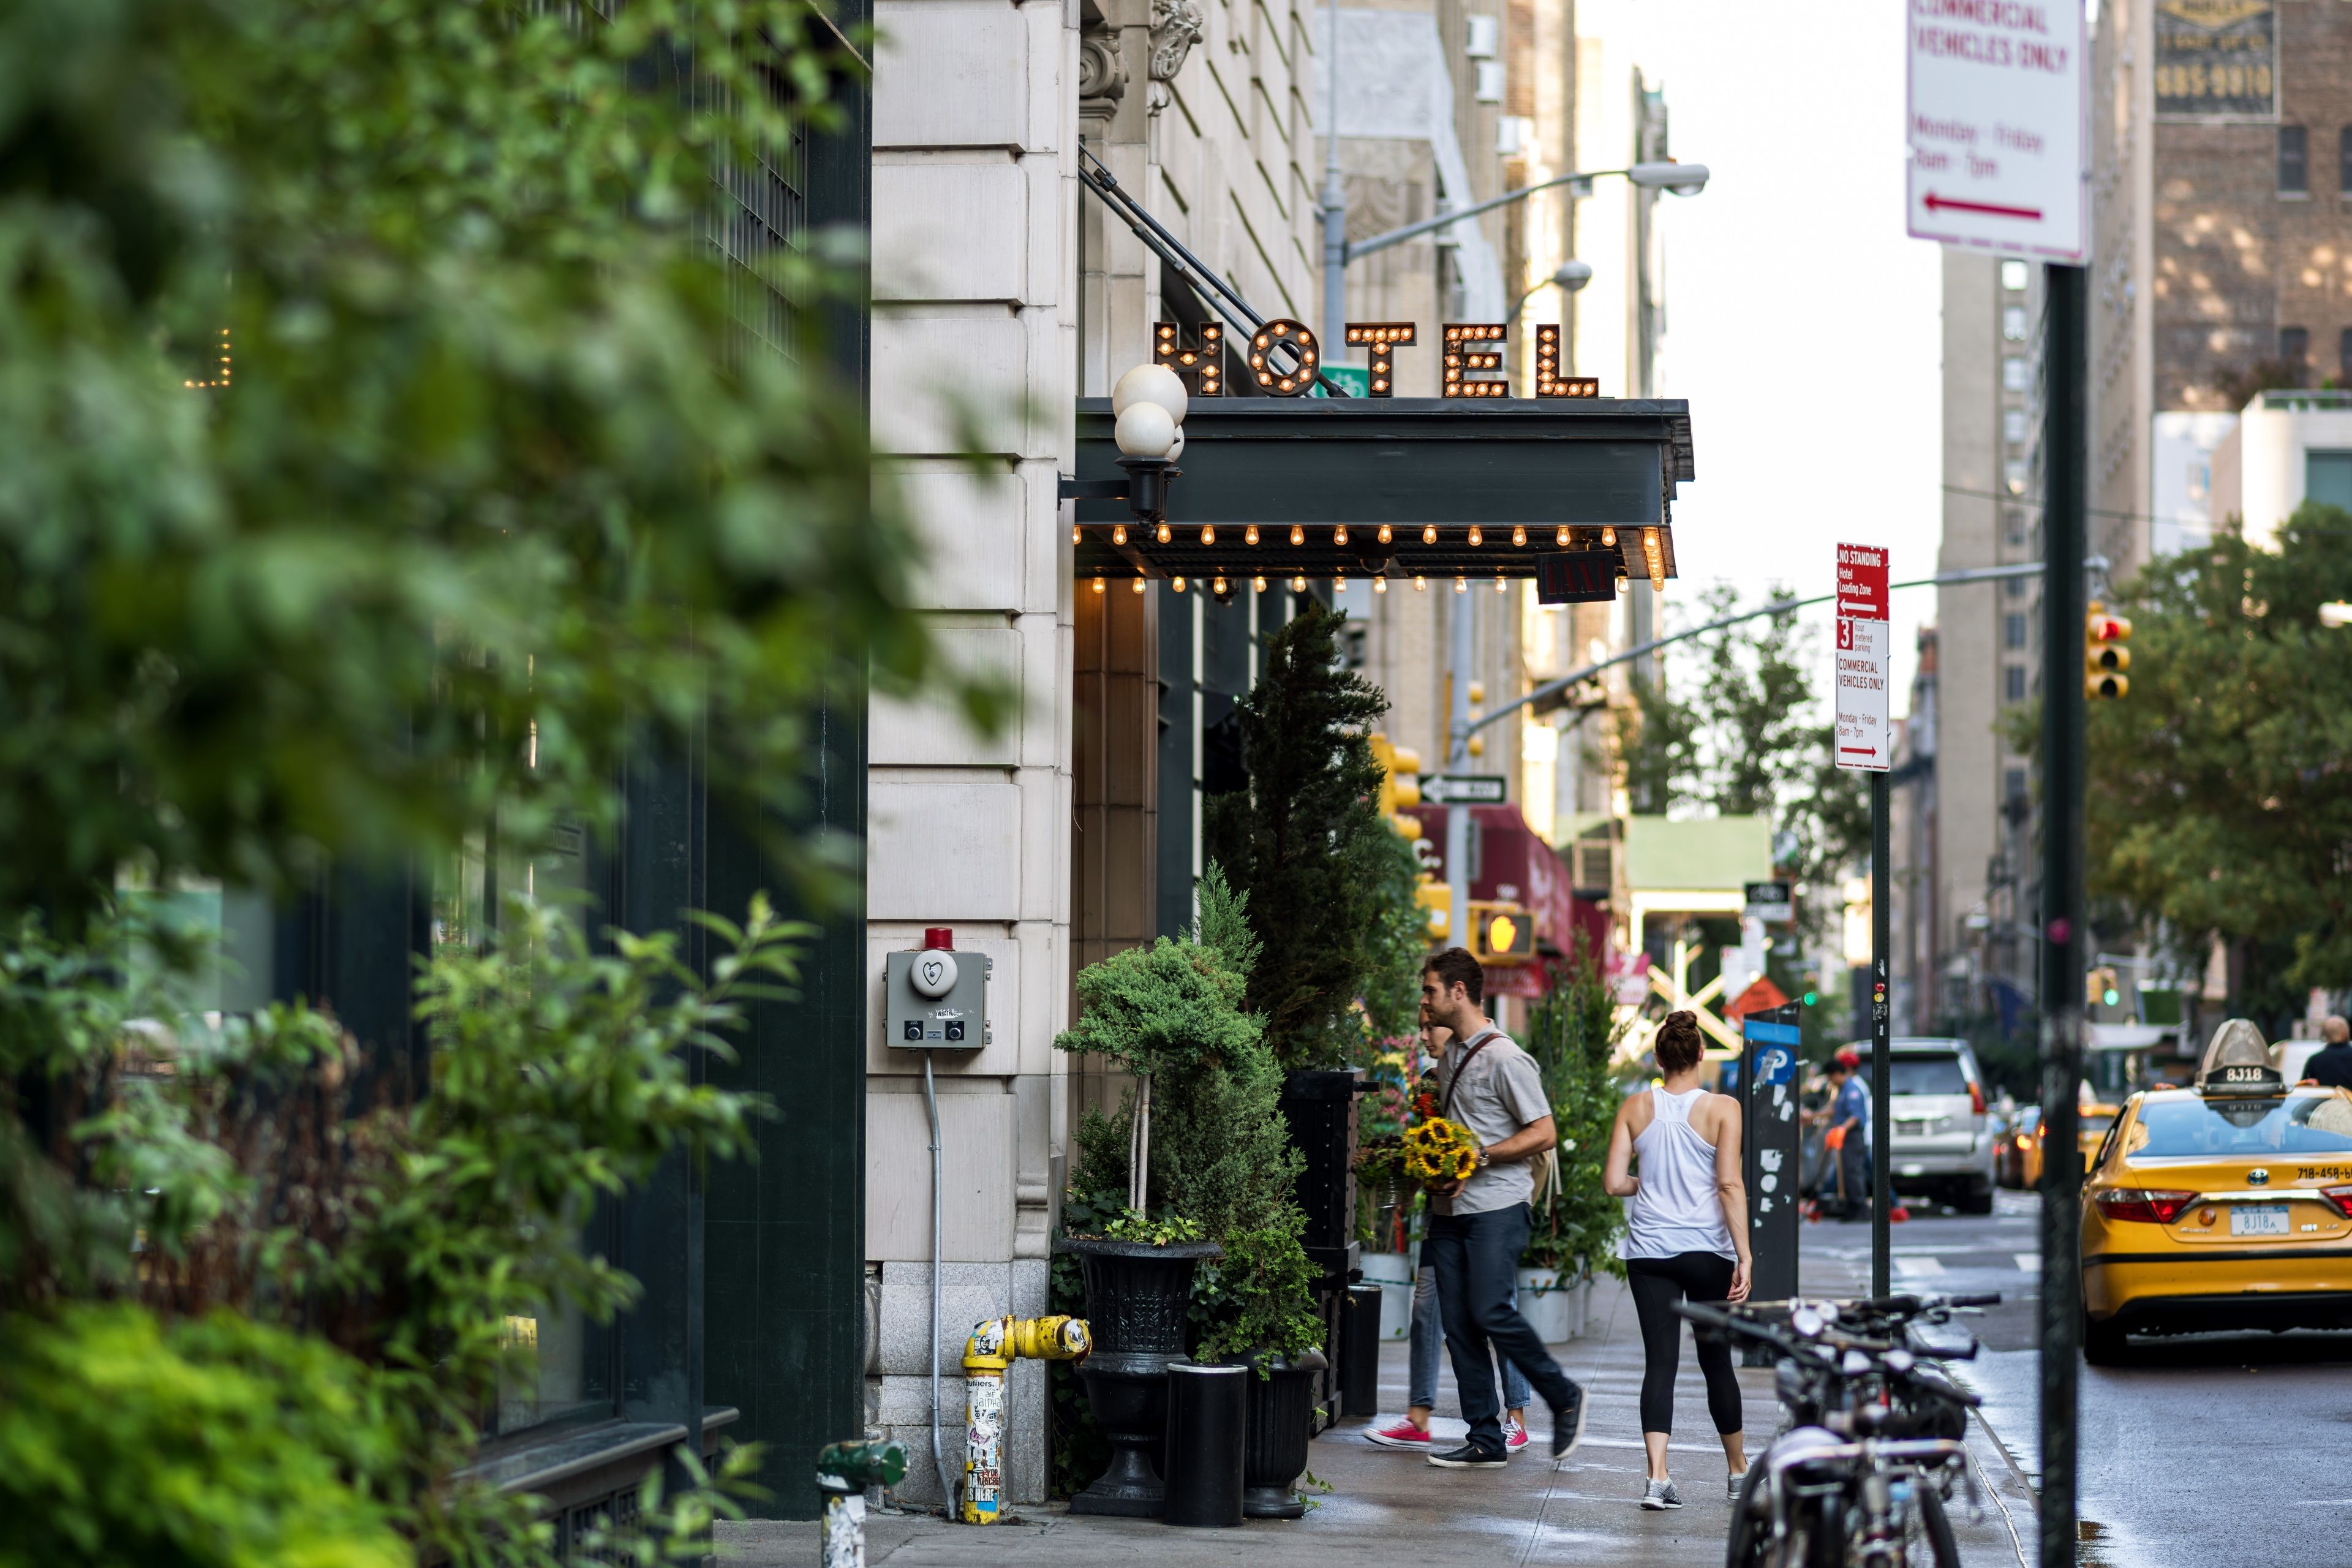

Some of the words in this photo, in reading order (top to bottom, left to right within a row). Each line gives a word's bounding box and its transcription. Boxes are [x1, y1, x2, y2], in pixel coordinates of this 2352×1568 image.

[1913, 26, 2013, 67] VEHICLES
[2019, 39, 2068, 74] ONLY
[1912, 113, 1977, 147] Monday
[1153, 318, 1599, 398] HOTEL
[1839, 549, 1849, 564] NO
[1850, 550, 1881, 567] STANDING
[1839, 567, 1853, 579] Hotel
[1839, 581, 1858, 597] Loading
[1859, 583, 1871, 596] Zone
[1841, 620, 1849, 647] 3
[1855, 623, 1864, 631] hour
[1855, 634, 1872, 643] metered
[1855, 644, 1871, 654] parking
[1839, 658, 1878, 674] COMMERCIAL
[1839, 674, 1868, 689] VEHICLES
[1869, 677, 1884, 690] ONLY
[1839, 712, 1858, 726] Monday
[1862, 714, 1877, 728] Friday
[1839, 725, 1850, 737] 8am
[1853, 726, 1864, 739] 7pm
[2226, 1067, 2263, 1082] 8J18
[2297, 1167, 2352, 1179] 718-458-6
[967, 1488, 974, 1501] IS
[975, 1488, 994, 1501] HERE
